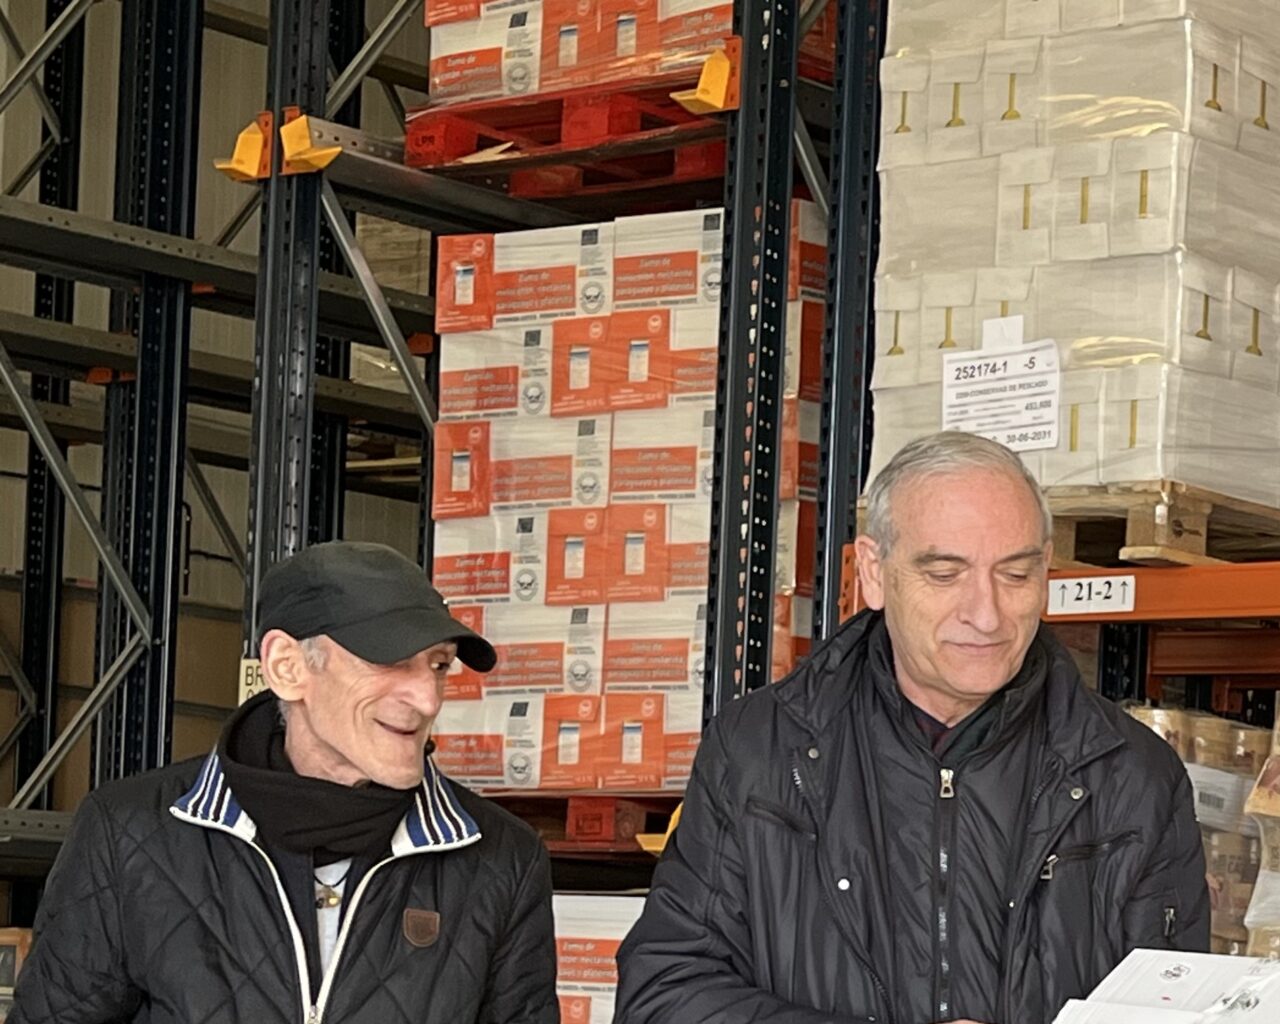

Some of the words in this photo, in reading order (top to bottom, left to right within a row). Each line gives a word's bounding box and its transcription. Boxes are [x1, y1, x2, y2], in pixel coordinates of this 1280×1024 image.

[954, 360, 1008, 381] 252174-1
[1024, 356, 1036, 370] -5
[1074, 580, 1112, 601] 21-2
